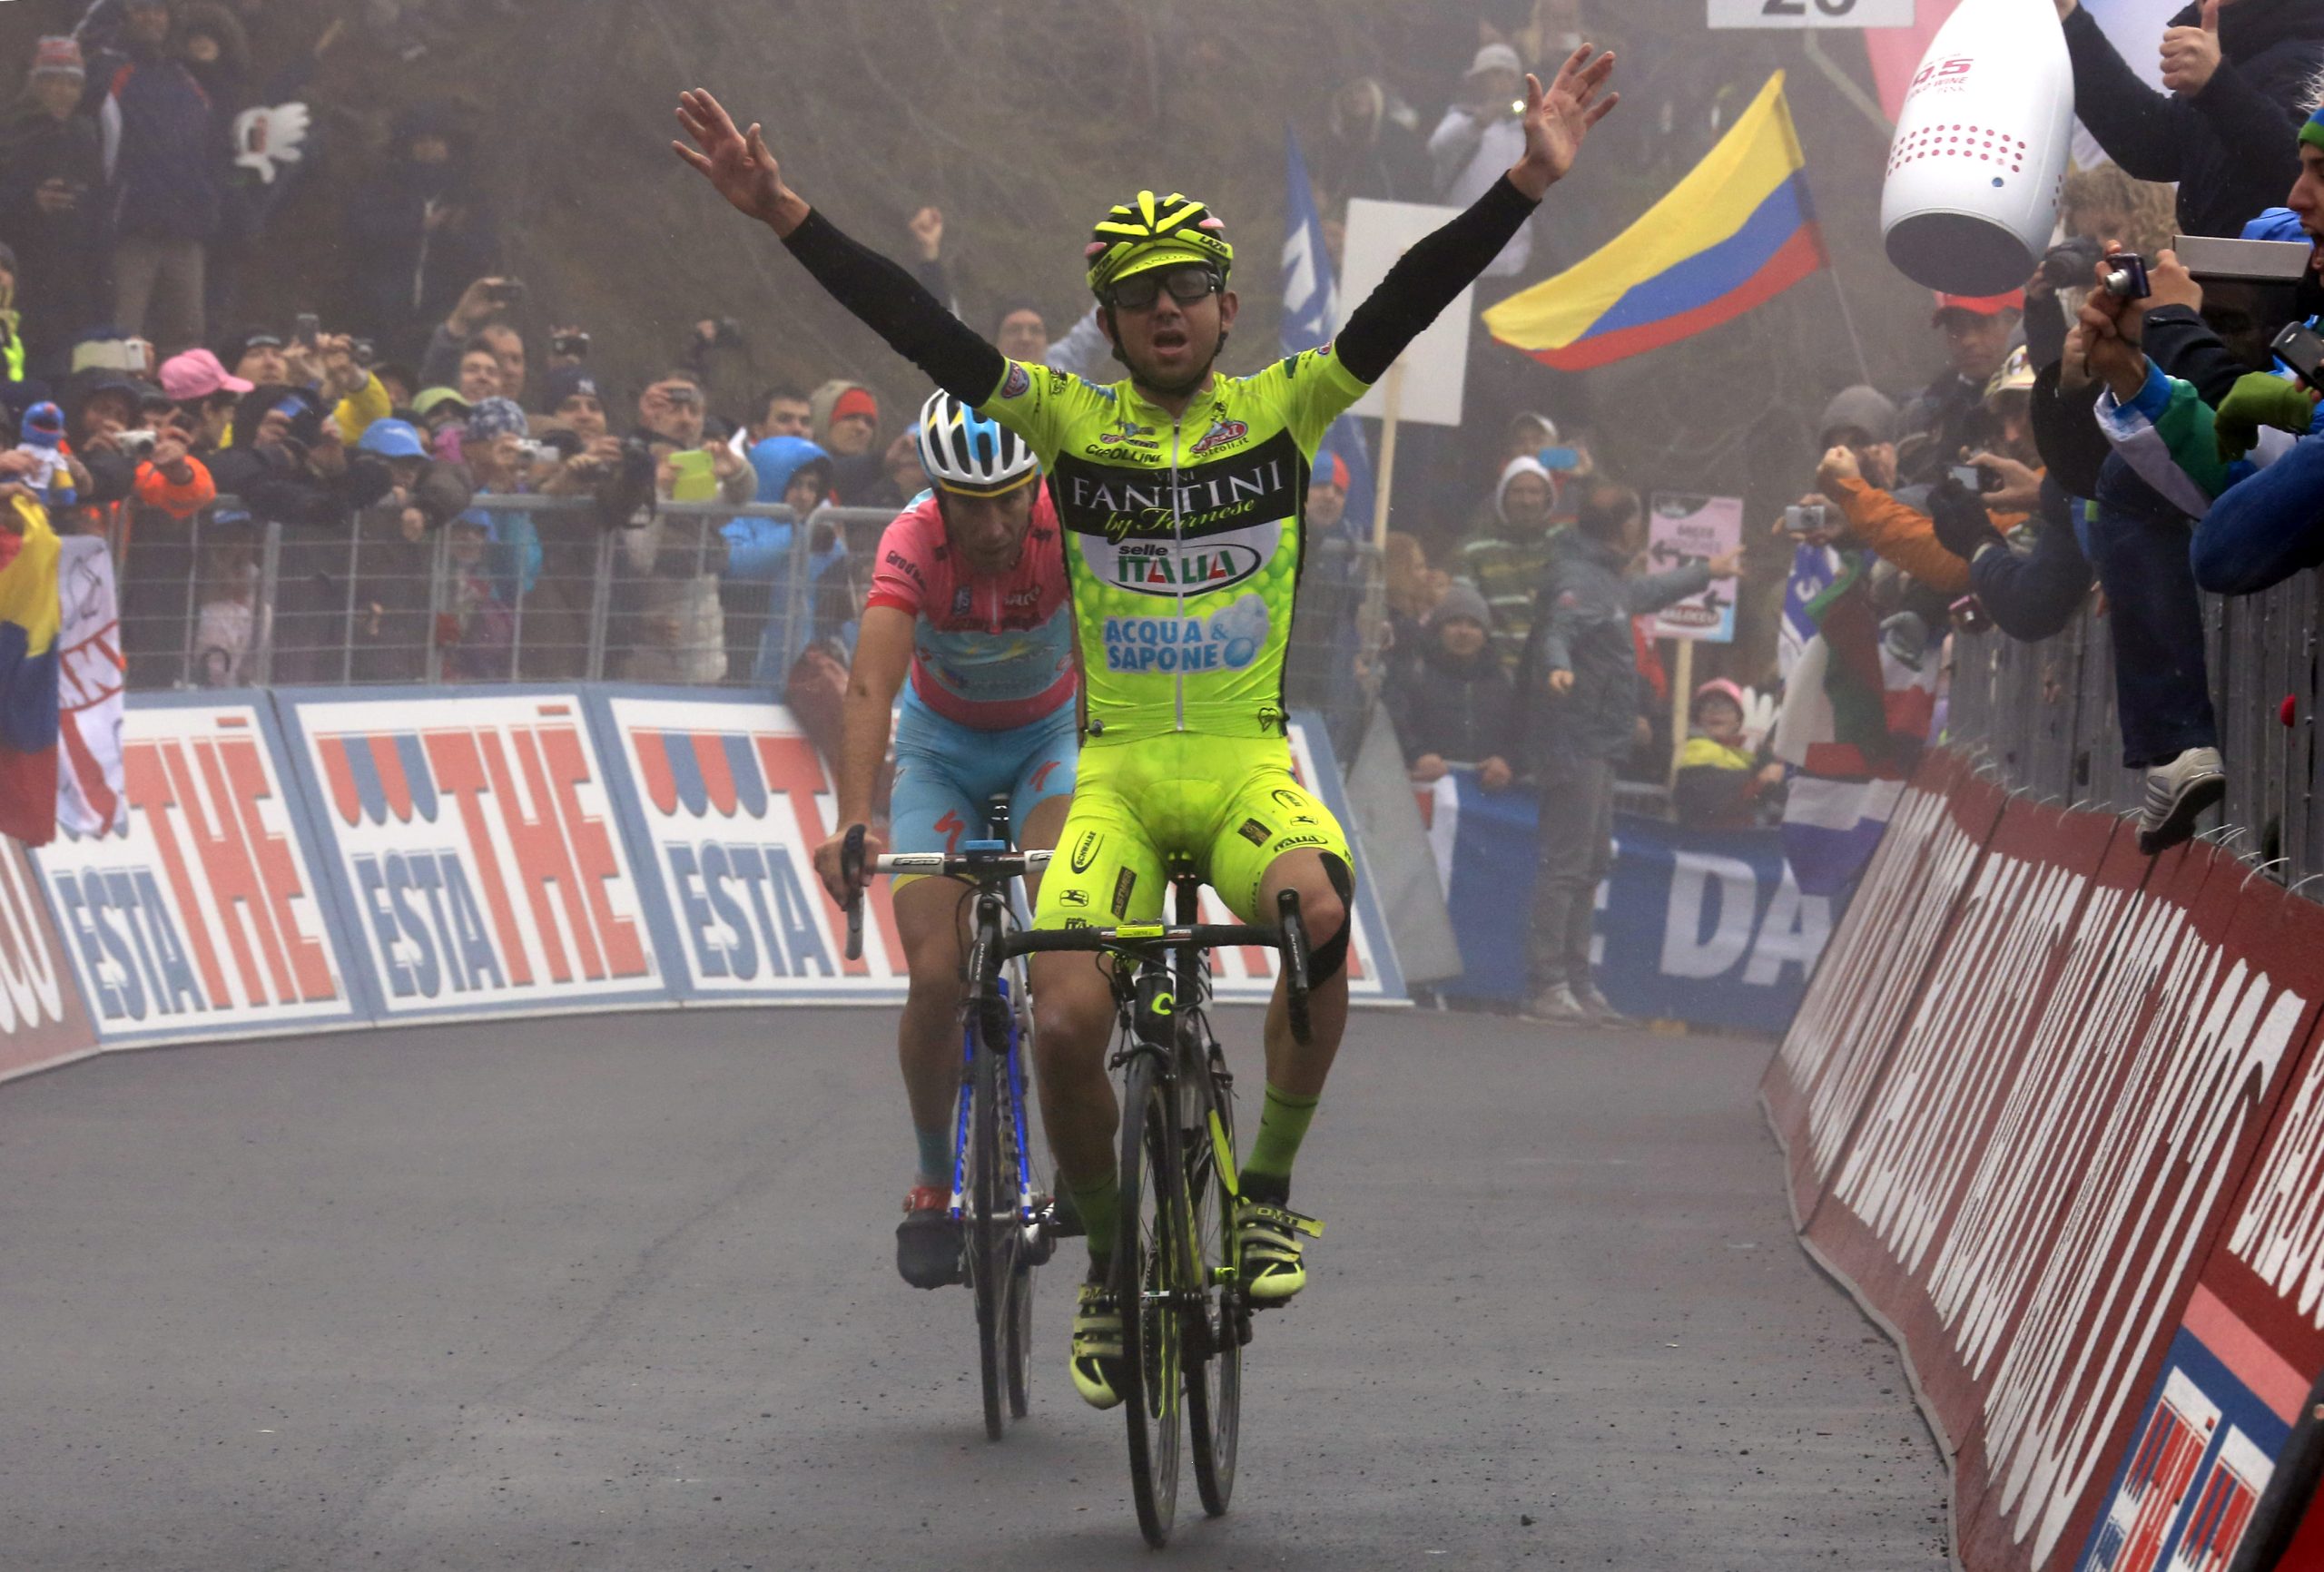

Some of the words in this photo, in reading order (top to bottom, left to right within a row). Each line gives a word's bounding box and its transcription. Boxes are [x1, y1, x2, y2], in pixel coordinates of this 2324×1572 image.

[1072, 458, 1284, 514] FANTINI
[1104, 512, 1134, 536] by
[1136, 497, 1256, 532] Farnese
[1118, 543, 1168, 557] selle
[1118, 549, 1237, 585] ITALIA
[1105, 619, 1203, 643] ACQUA
[1210, 623, 1228, 641] &
[1108, 644, 1217, 671] SAPONE
[1076, 830, 1097, 866] SCHWALBE
